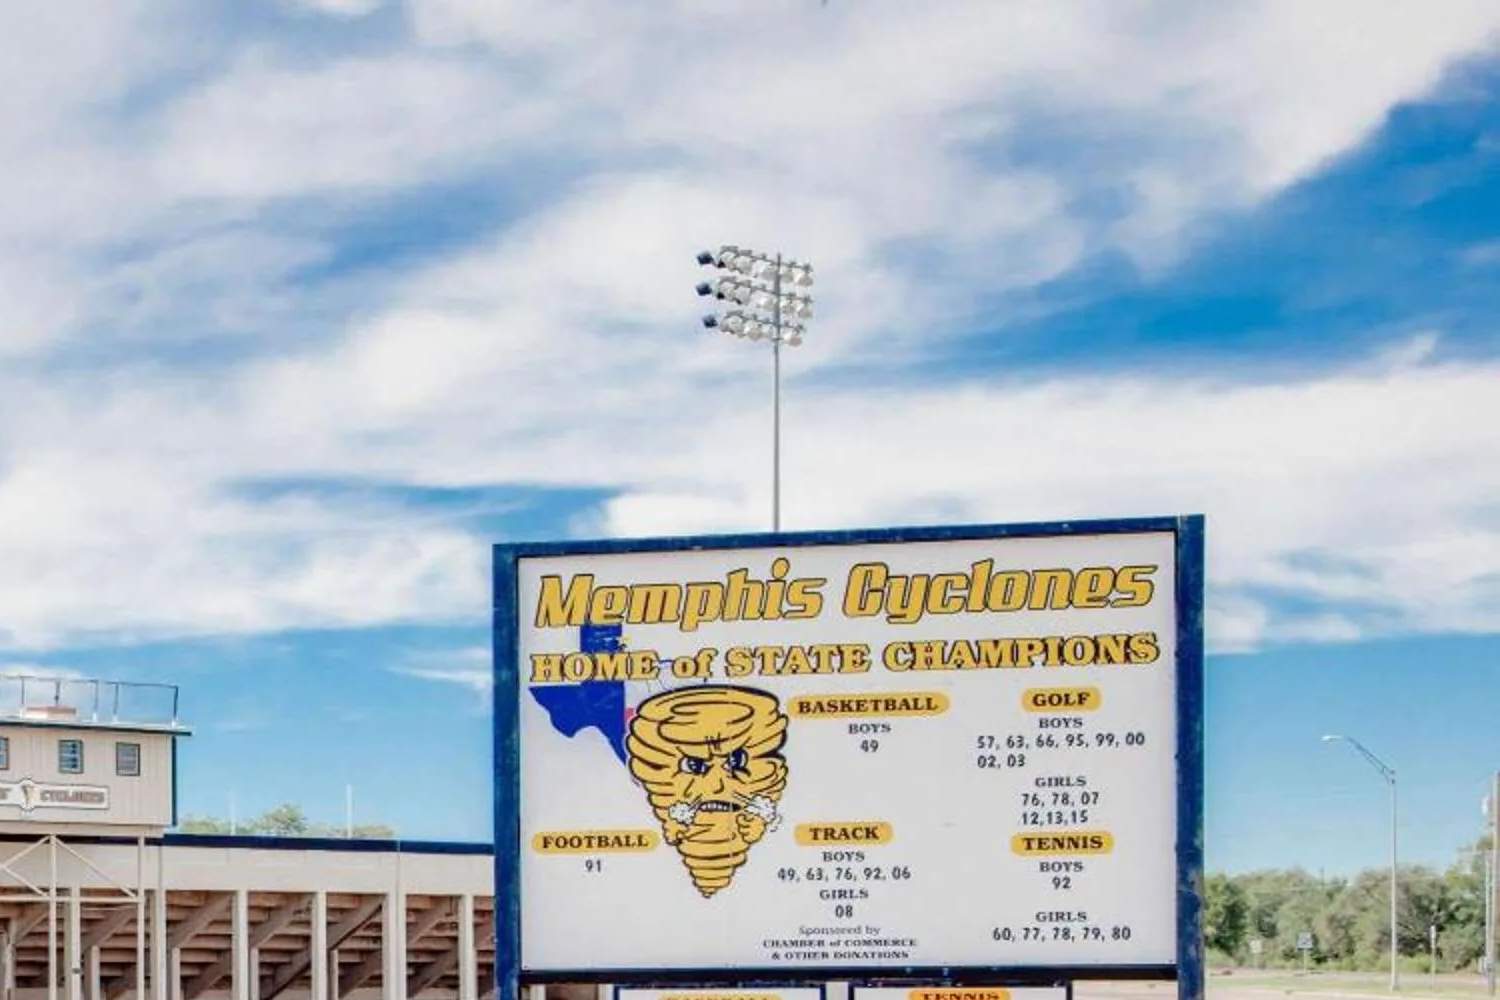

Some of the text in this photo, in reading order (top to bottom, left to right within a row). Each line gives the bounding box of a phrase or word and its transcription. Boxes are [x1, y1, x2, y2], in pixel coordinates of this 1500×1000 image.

[534, 557, 1158, 632] Memphis Cyclones
[530, 631, 1160, 682] HOME of STATE CHAMPIONS
[798, 697, 938, 714] BASKETBALL
[1032, 692, 1090, 707] GOLF
[848, 723, 891, 734] BOYS
[1039, 717, 1083, 729] BOYS
[860, 739, 879, 752] 49
[977, 735, 999, 750] 57,
[1006, 735, 1029, 750] 63,
[1065, 733, 1089, 748] 95,
[1095, 733, 1119, 748] 99,
[1125, 731, 1145, 746] 00
[977, 754, 1026, 769] 02, 03
[1035, 776, 1087, 787] GIRLS
[1022, 791, 1100, 807] 76, 78, 07
[810, 826, 880, 841] TRACK
[542, 834, 649, 849] FOOTBALL
[1022, 835, 1104, 851] TENNIS
[822, 851, 865, 862] BOYS
[585, 859, 602, 872] 91
[1039, 861, 1084, 873] BOYS
[806, 867, 828, 882] 63,
[891, 865, 911, 880] 06
[1052, 876, 1071, 890] 92
[820, 889, 869, 900] GIRLS
[835, 905, 854, 918] 08
[1035, 911, 1087, 923] GIRLS
[800, 925, 881, 936] Sponsored by
[992, 926, 1132, 943] 60, 77, 78, 79, 80
[763, 938, 917, 948] CHAMBER of COMMERCE
[771, 950, 910, 960] & OTHER DONATIONS
[921, 992, 1000, 1000] TENNIS
